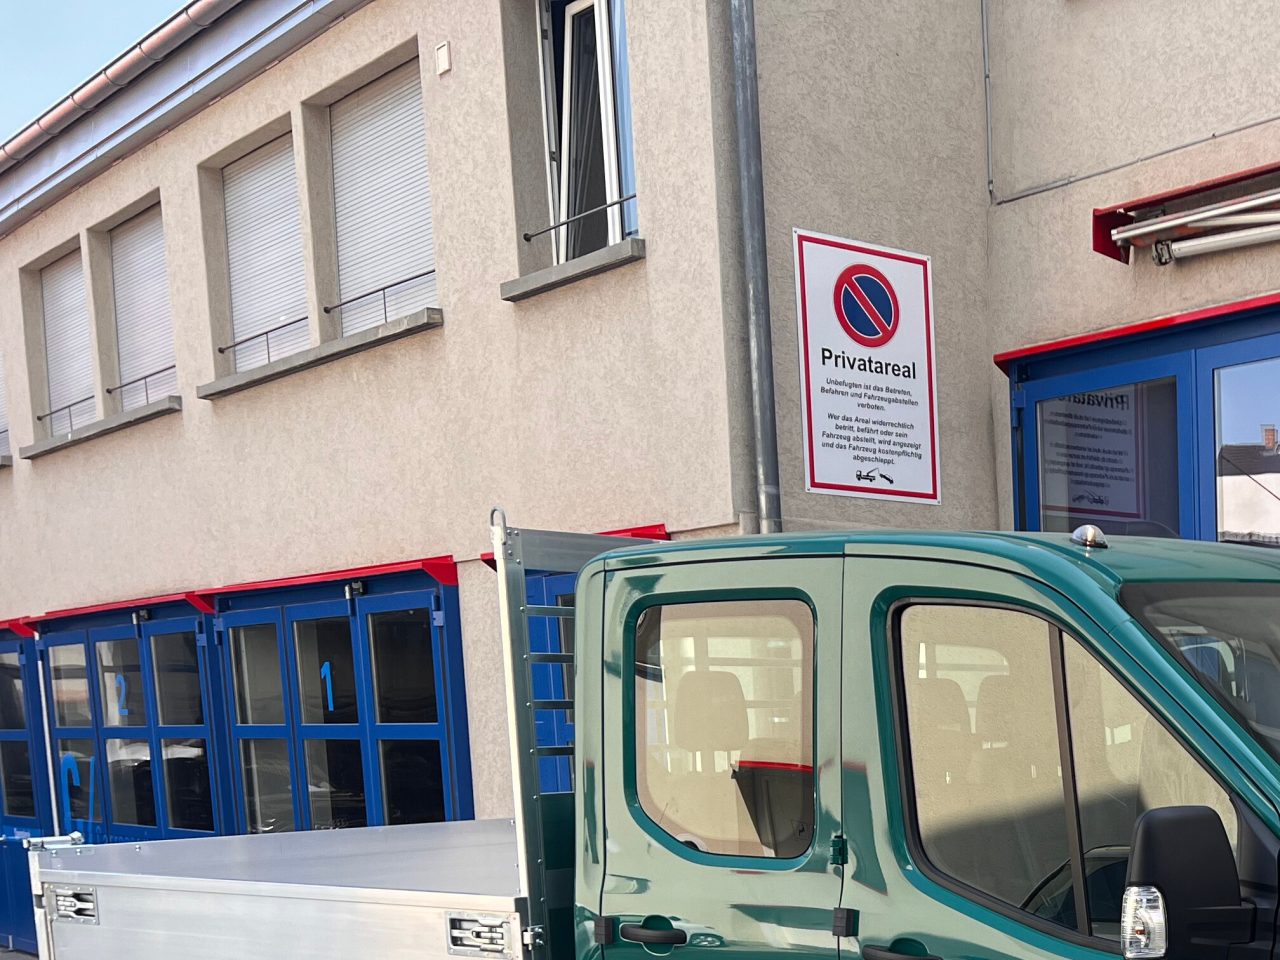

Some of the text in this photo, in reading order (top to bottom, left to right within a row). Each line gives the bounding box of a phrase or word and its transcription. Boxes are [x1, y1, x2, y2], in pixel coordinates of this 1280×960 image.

[821, 348, 917, 379] Privatareal
[820, 386, 919, 406] Befahren und Fahrzeugabstellen
[826, 378, 862, 389] Unbefugten
[872, 384, 884, 392] das
[885, 386, 912, 396] Betreten,
[857, 401, 886, 411] verboten.
[827, 412, 915, 430] Wer das Areal widerrechtlich
[835, 423, 855, 432] betritt,
[856, 426, 879, 435] befährt
[880, 429, 894, 437] oder
[821, 431, 922, 451] Fahrzeug abstellt, wird angezeigt
[835, 442, 847, 450] das
[848, 443, 877, 454] Fahrzeug
[877, 447, 923, 460] kostenpflichtig
[852, 454, 895, 465] abgeschleppt.
[116, 674, 129, 716] 2
[320, 661, 335, 712] 1
